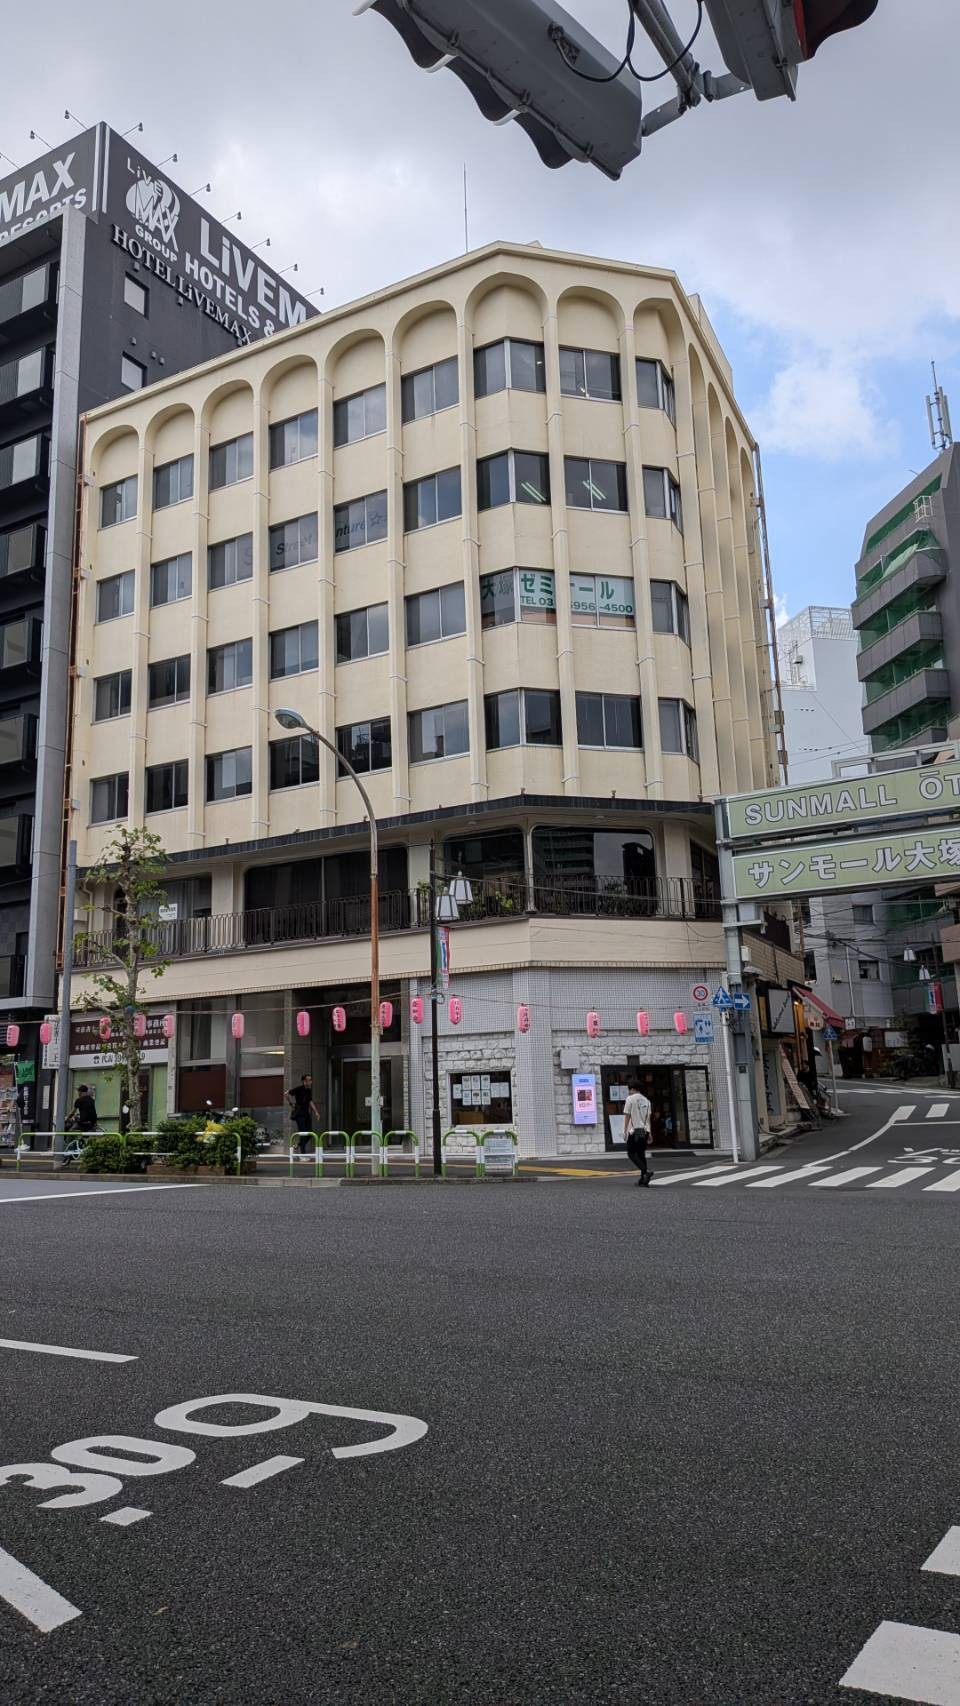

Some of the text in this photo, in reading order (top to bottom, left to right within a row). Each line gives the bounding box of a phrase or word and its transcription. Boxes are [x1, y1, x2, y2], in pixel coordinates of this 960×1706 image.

[135, 225, 178, 262] GROUP
[112, 223, 252, 346] HOTEL LiVEMAX
[185, 251, 260, 329] HOTELS
[520, 595, 536, 605] TEL
[744, 784, 898, 826] SUNMALL
[748, 838, 960, 889] サンモール大塚
